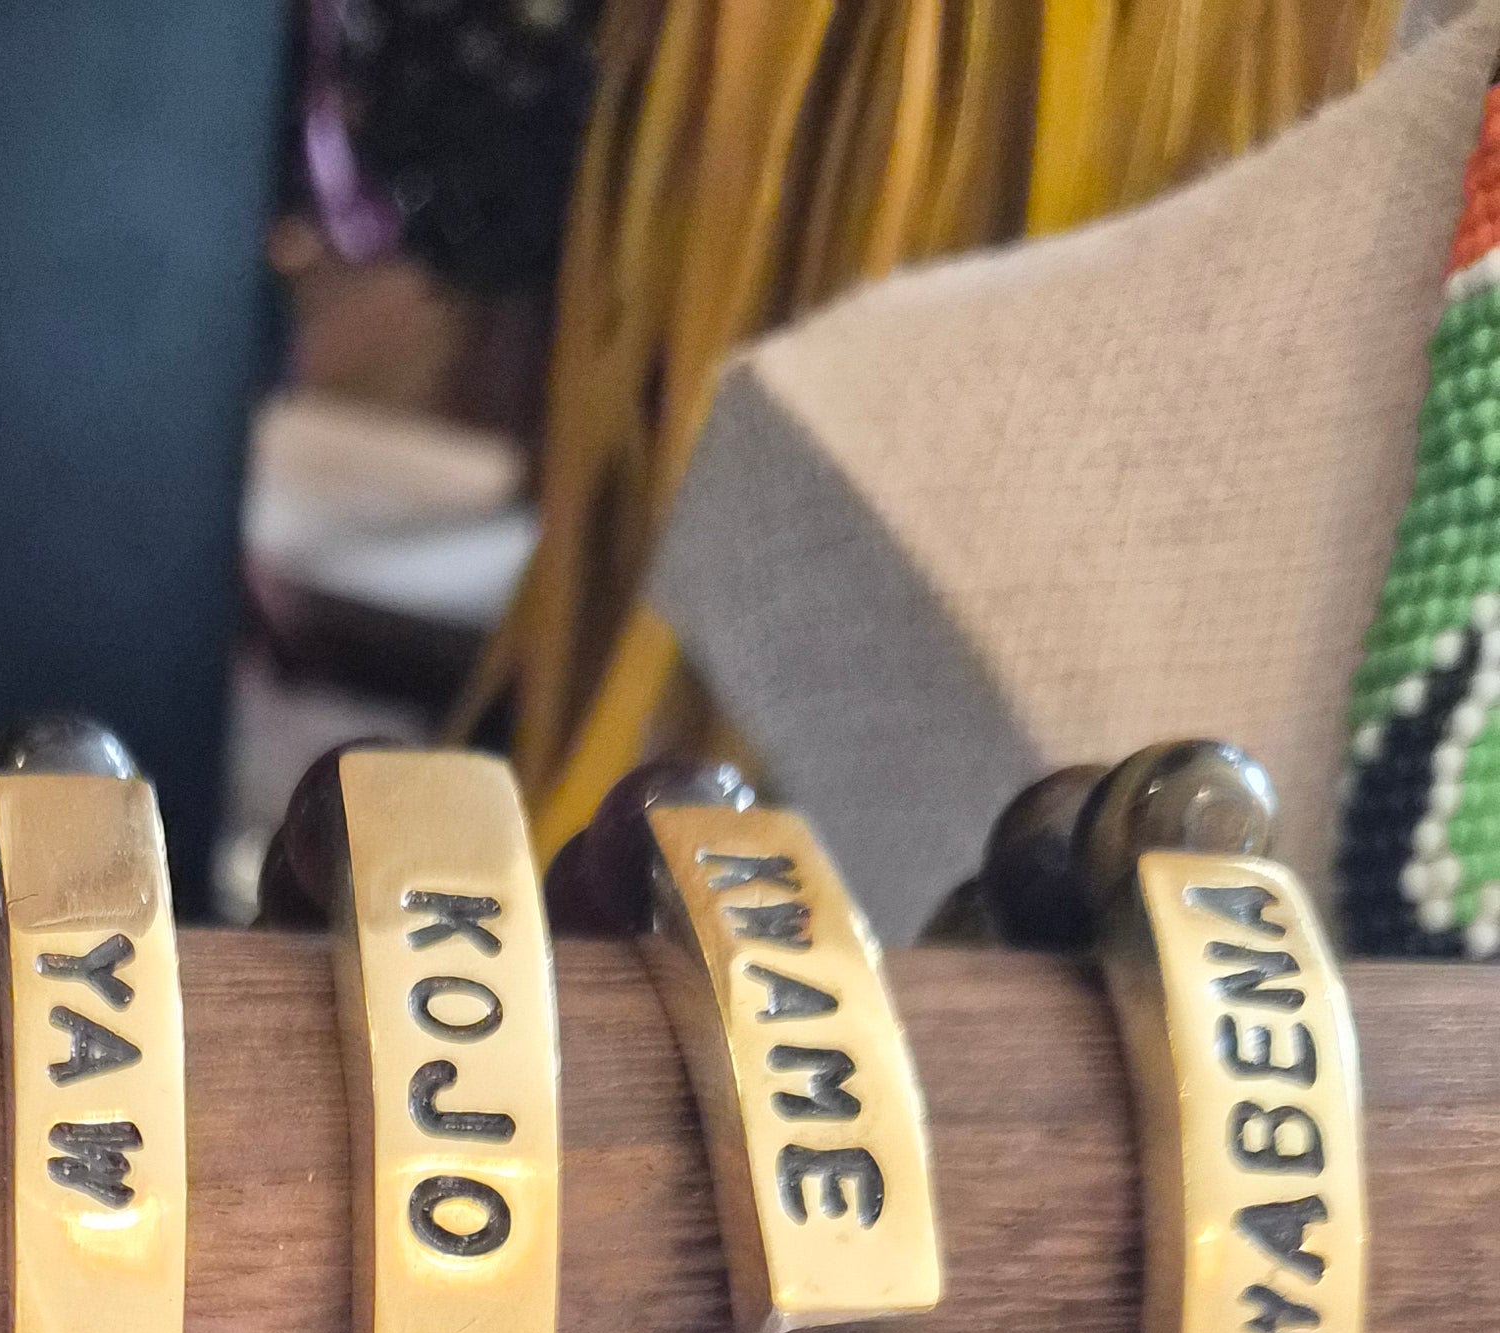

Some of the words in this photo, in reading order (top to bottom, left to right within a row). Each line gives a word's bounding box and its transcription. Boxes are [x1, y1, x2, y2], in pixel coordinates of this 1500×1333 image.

[35, 932, 142, 1209] YAW
[400, 890, 516, 1257] KOJO
[695, 849, 885, 1229] KWAME
